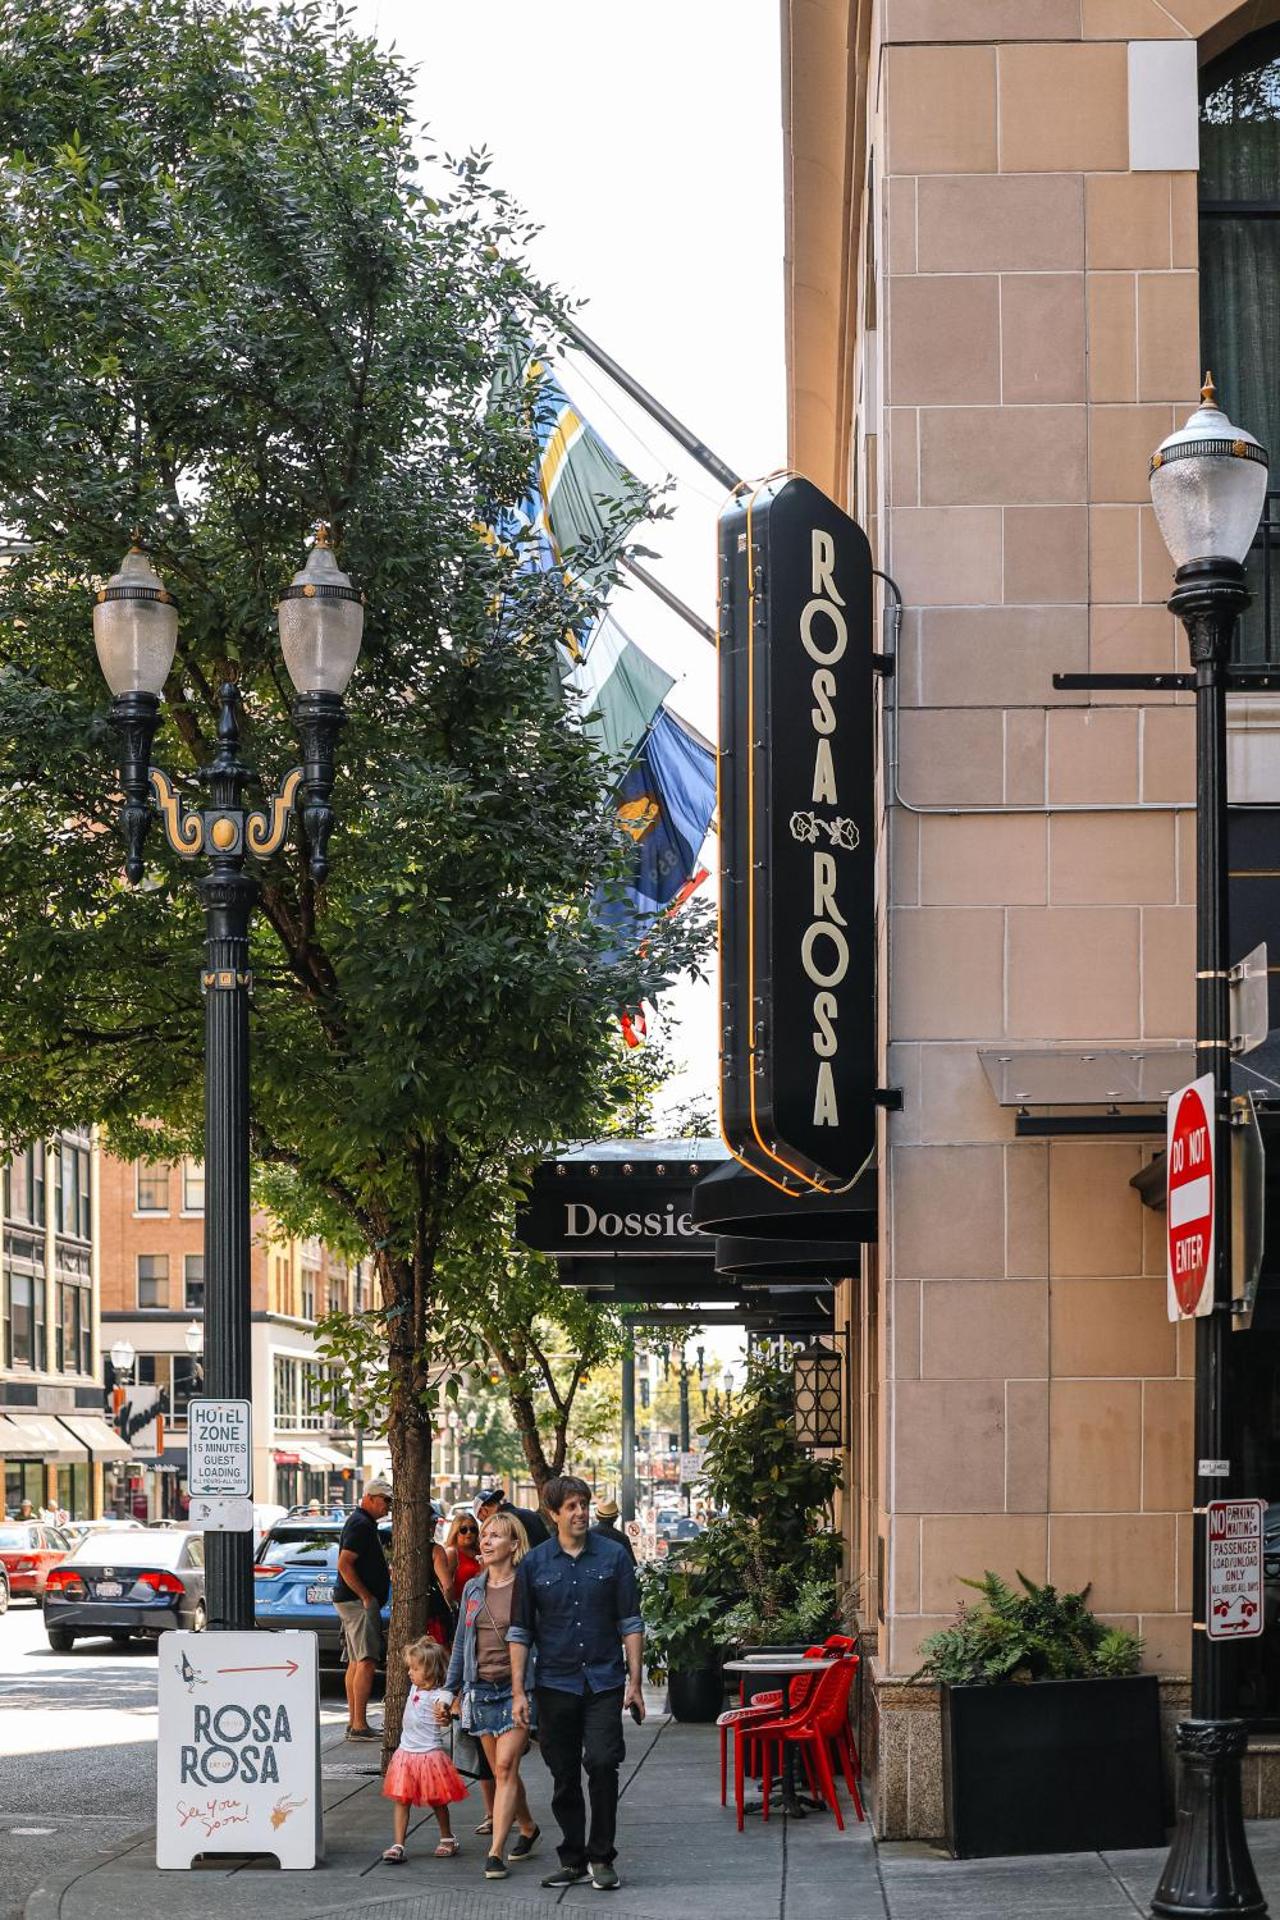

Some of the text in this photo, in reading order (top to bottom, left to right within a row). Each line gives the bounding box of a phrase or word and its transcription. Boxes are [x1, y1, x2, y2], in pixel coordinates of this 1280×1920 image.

[800, 528, 849, 1127] ROSA ROSA
[1173, 1126, 1206, 1174] DO NOT
[564, 1203, 718, 1236] Dossie
[1175, 1233, 1203, 1274] ENTER
[195, 1408, 244, 1423] HOTEL
[199, 1426, 240, 1440] ZONE
[193, 1443, 247, 1453] 15 MINUTES
[204, 1456, 236, 1465] GUEST
[199, 1467, 241, 1478] LOADING
[1210, 1507, 1255, 1535] NO PARKING
[1212, 1556, 1258, 1569] LOAD/UNLOAD
[1213, 1541, 1258, 1556] PASSENGER
[1225, 1569, 1246, 1582] ONLY
[194, 1704, 292, 1746] ROSA
[180, 1744, 280, 1787] ROSA
[176, 1800, 206, 1828] See
[201, 1804, 249, 1838] Soon!
